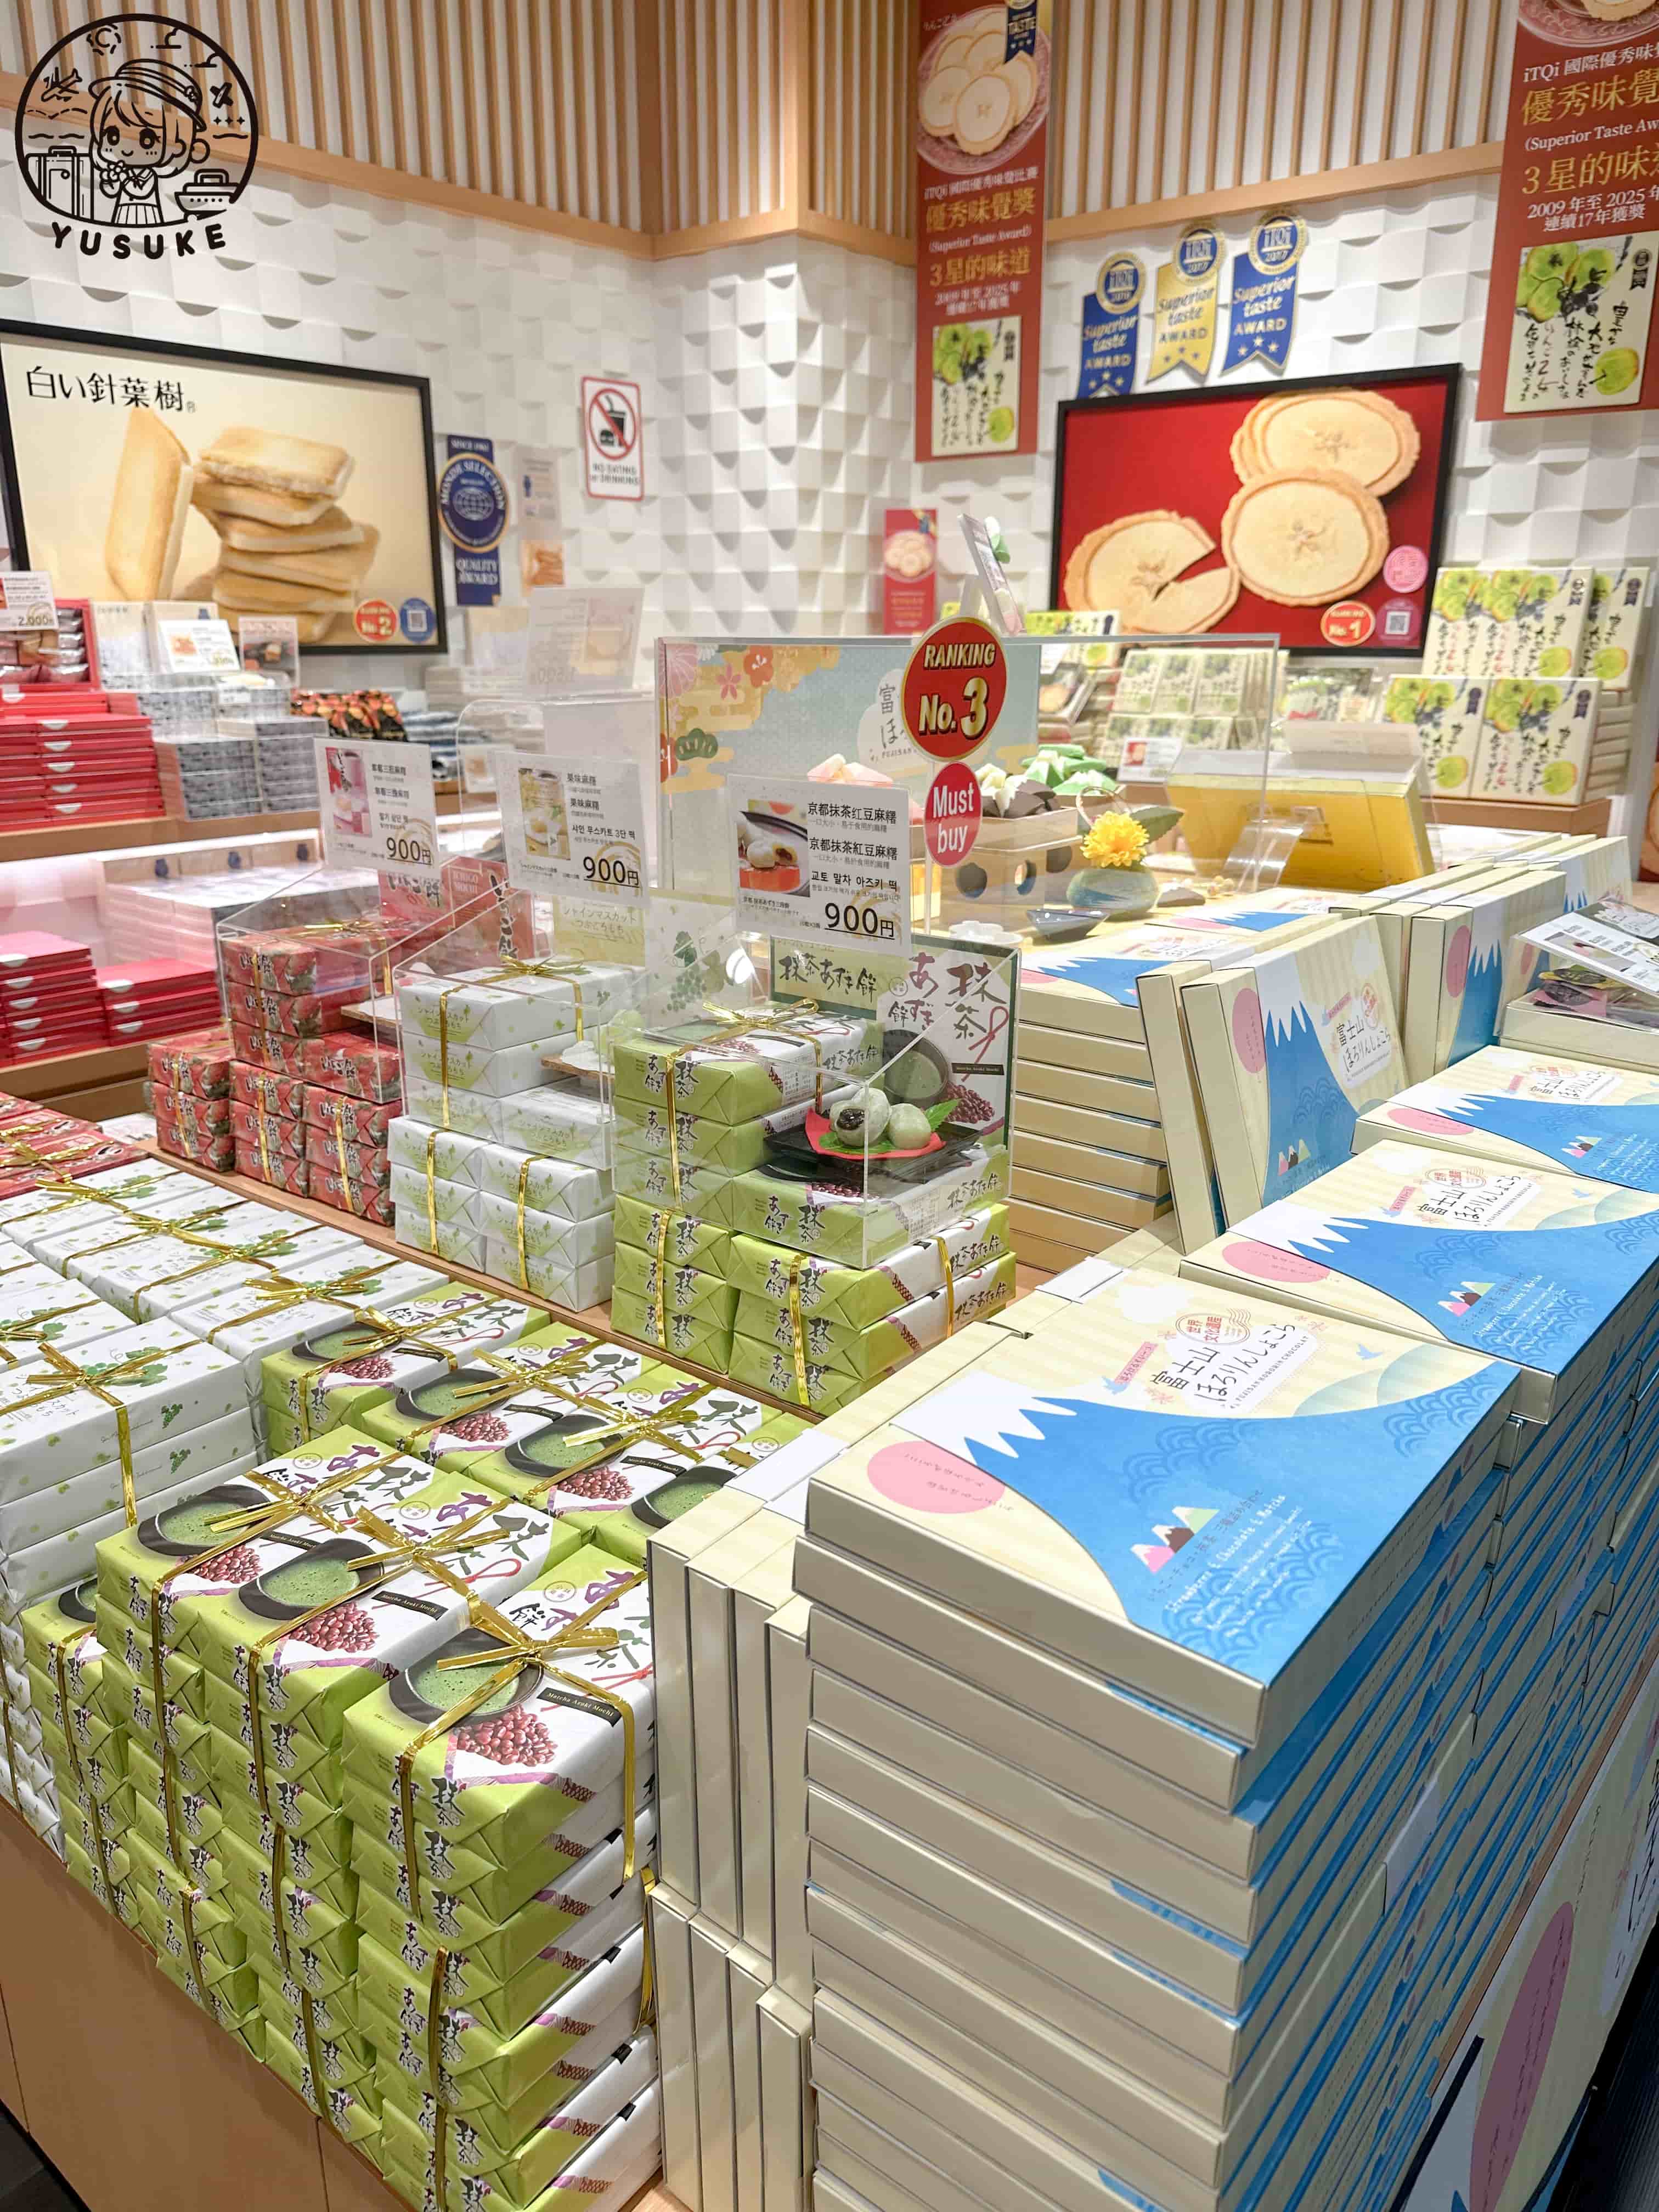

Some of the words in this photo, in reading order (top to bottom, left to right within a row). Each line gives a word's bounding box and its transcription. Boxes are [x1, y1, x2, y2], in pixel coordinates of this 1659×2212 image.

[1523, 63, 1560, 82] iTQi
[1564, 43, 1659, 76] 國際優秀味
[1525, 130, 1592, 151] (Superior
[1594, 122, 1633, 139] Taste
[1527, 201, 1565, 218] 2009
[1606, 188, 1646, 207] 2025
[1159, 287, 1215, 314] Superior
[1233, 275, 1296, 303] Superior
[1083, 315, 1138, 341] Superior
[1159, 328, 1207, 343] AWARD
[1234, 318, 1288, 335] AWARD
[1085, 354, 1131, 369] AWARD
[26, 366, 183, 413] 白い針葉樹
[593, 464, 605, 472] NO
[923, 642, 996, 669] RANKING
[808, 802, 897, 824] 京都抹茶红豆麻糬
[933, 786, 974, 819] Must
[386, 837, 431, 863] 900円
[809, 837, 898, 860] 京都抹茶紅豆麻糬
[937, 823, 968, 855] buy
[583, 856, 640, 885] 900円
[812, 871, 829, 882] 교토
[833, 873, 851, 886] 말차
[856, 877, 883, 890] 아즈키
[824, 903, 894, 938] 900円
[1417, 1189, 1468, 1216] 富士山
[1150, 1347, 1221, 1390] 富士山
[1194, 1324, 1295, 1402] ほろりんしょこら
[382, 1593, 403, 1603] Matcha
[404, 1598, 419, 1607] Azuki
[419, 1602, 439, 1613] Mochi
[547, 1691, 572, 1702] Matcha
[572, 1697, 593, 1708] Azuki
[593, 1703, 615, 1718] Mochi
